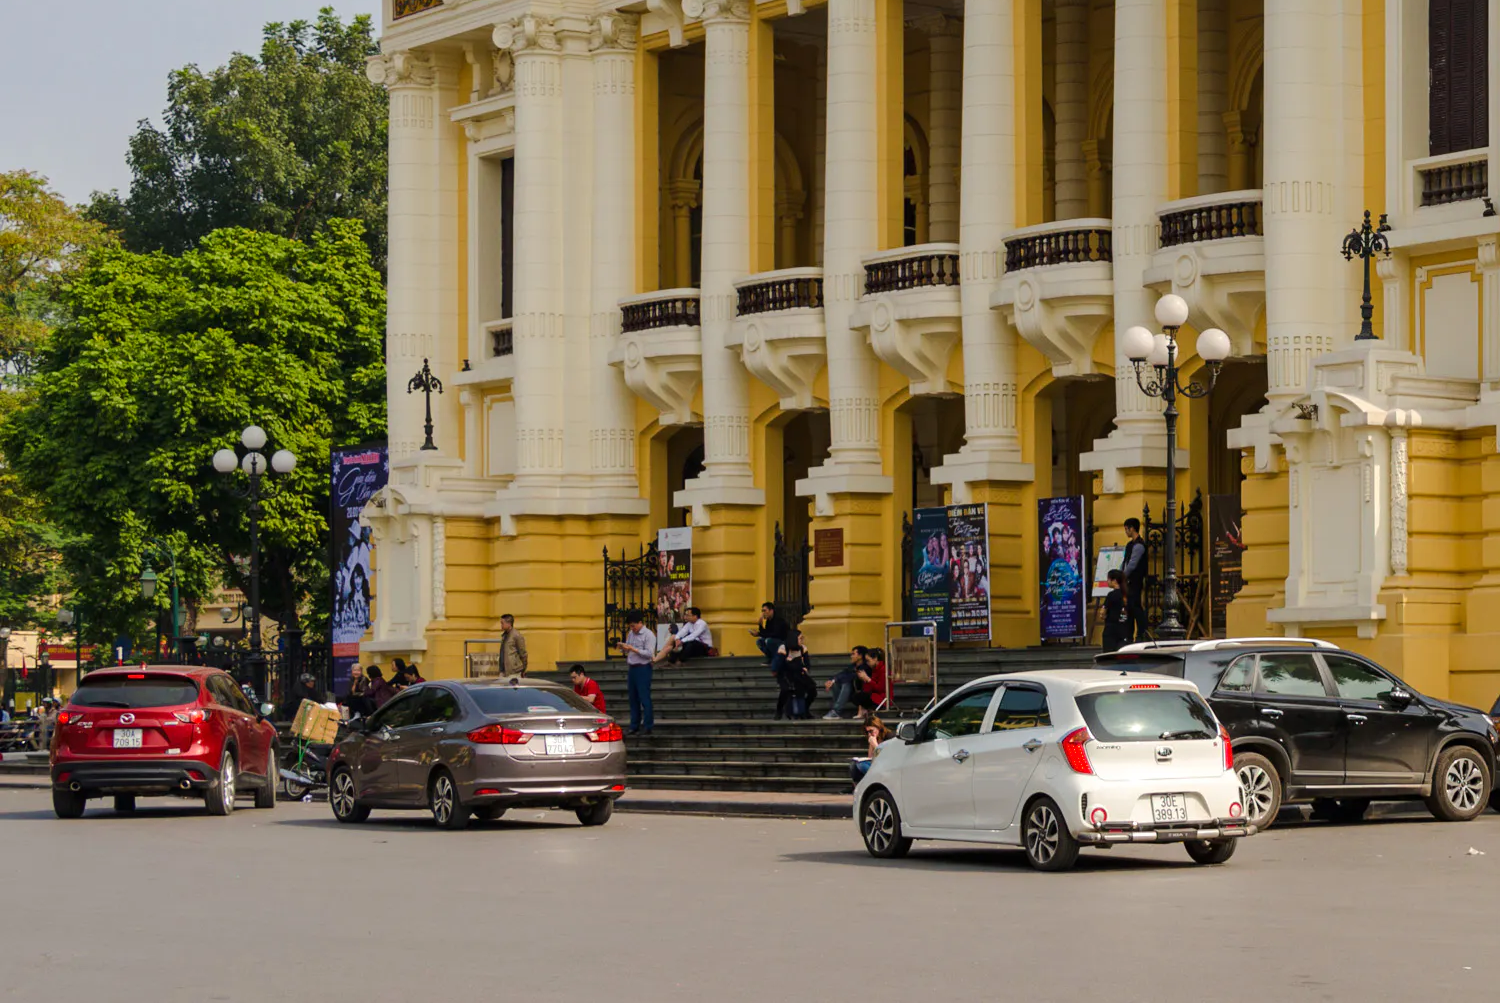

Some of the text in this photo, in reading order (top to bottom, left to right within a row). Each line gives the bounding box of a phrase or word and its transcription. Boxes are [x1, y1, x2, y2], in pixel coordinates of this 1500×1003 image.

[119, 728, 136, 738] 30A
[1160, 795, 1178, 808] 30E
[1155, 807, 1186, 821] 389.13
